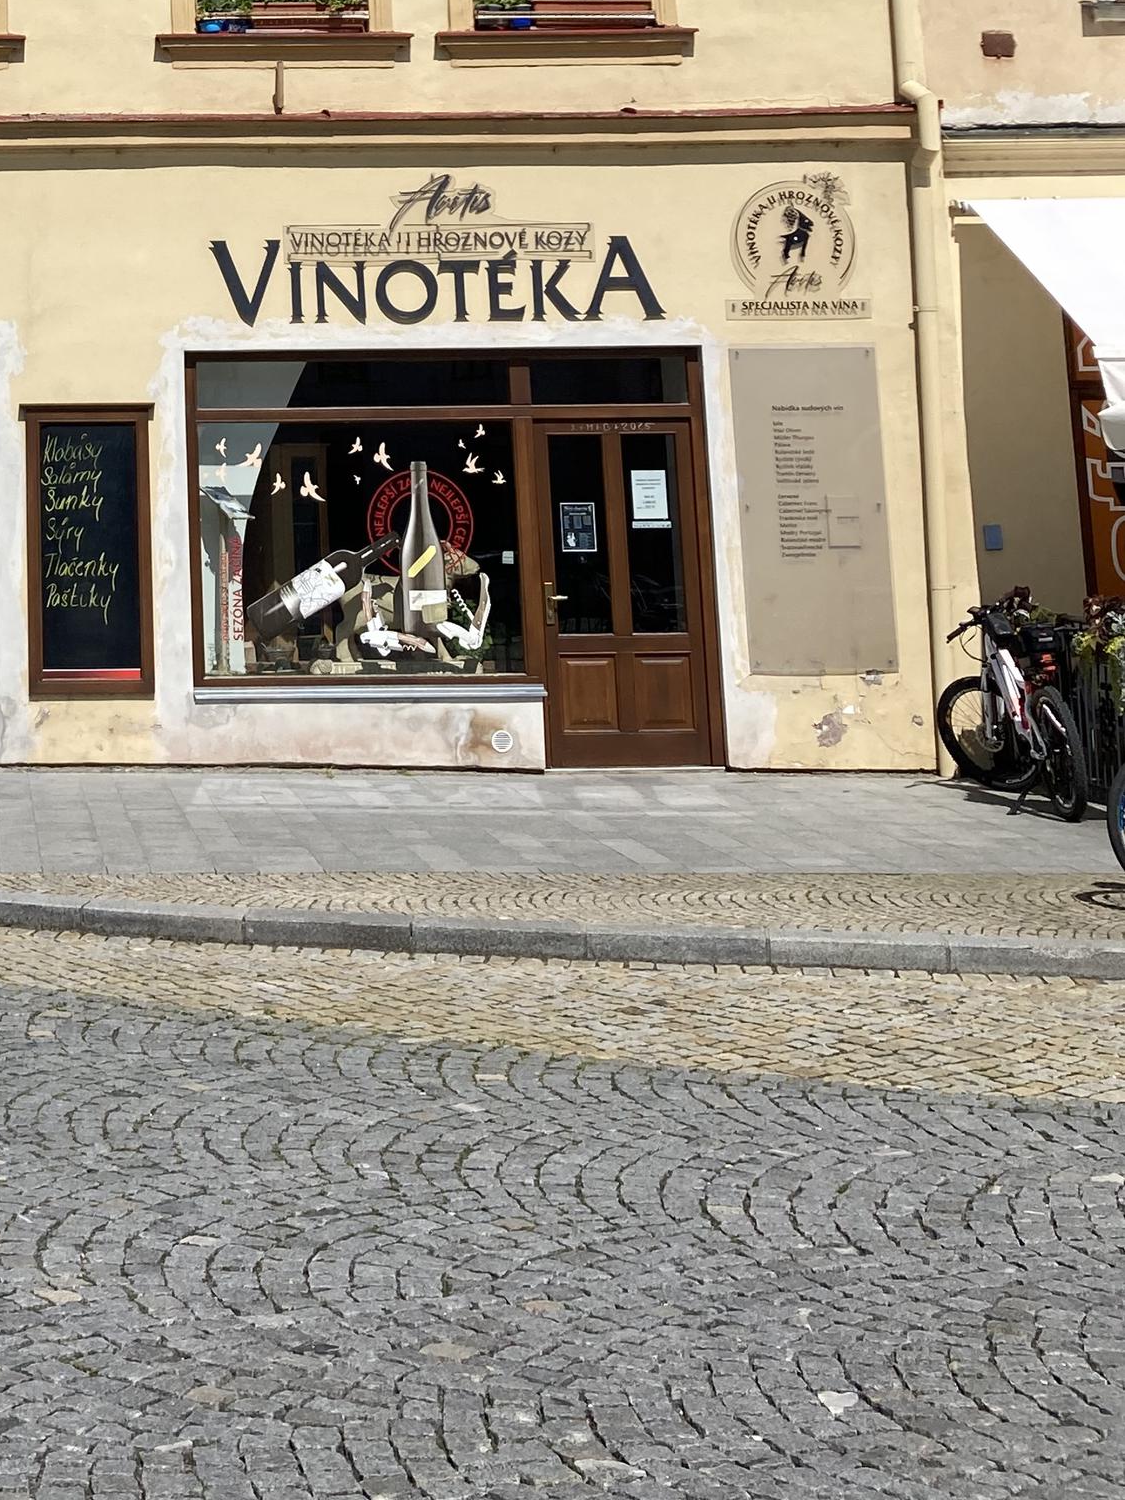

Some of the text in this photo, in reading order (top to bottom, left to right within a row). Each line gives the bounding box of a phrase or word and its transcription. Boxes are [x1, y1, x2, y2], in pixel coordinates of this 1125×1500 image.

[291, 229, 390, 247] VINOTÉKA
[418, 229, 528, 248] HROZNOVÉ
[535, 230, 588, 248] KOZY
[209, 236, 667, 328] VINOTÉKA
[742, 301, 809, 310] SPECIALISTA
[813, 301, 827, 310] NA
[43, 433, 103, 470] Klobásy
[45, 486, 104, 521] Šunky
[46, 517, 84, 554] Sýry
[230, 589, 244, 641] SEZÓNA
